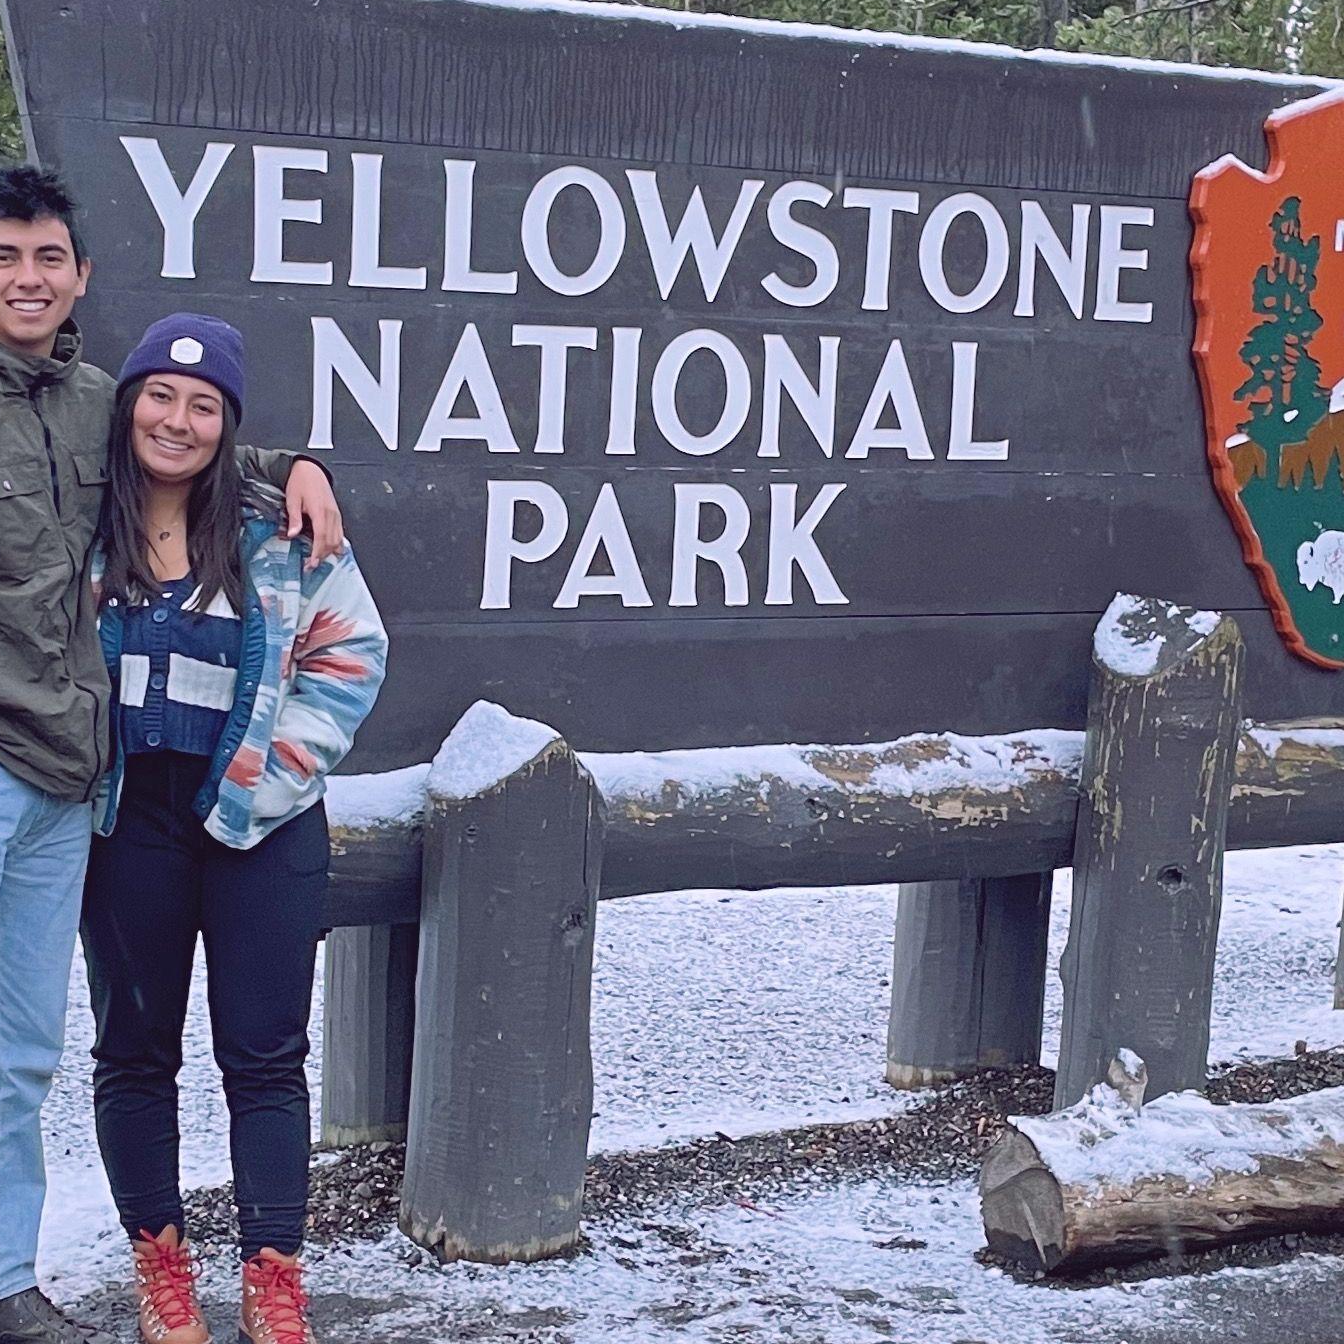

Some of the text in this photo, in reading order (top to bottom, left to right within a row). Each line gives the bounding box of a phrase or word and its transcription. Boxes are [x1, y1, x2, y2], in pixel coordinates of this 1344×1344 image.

[118, 135, 1155, 323] YELLOWSTONE
[307, 316, 1010, 461] NATIONAL
[479, 479, 850, 610] PARK
